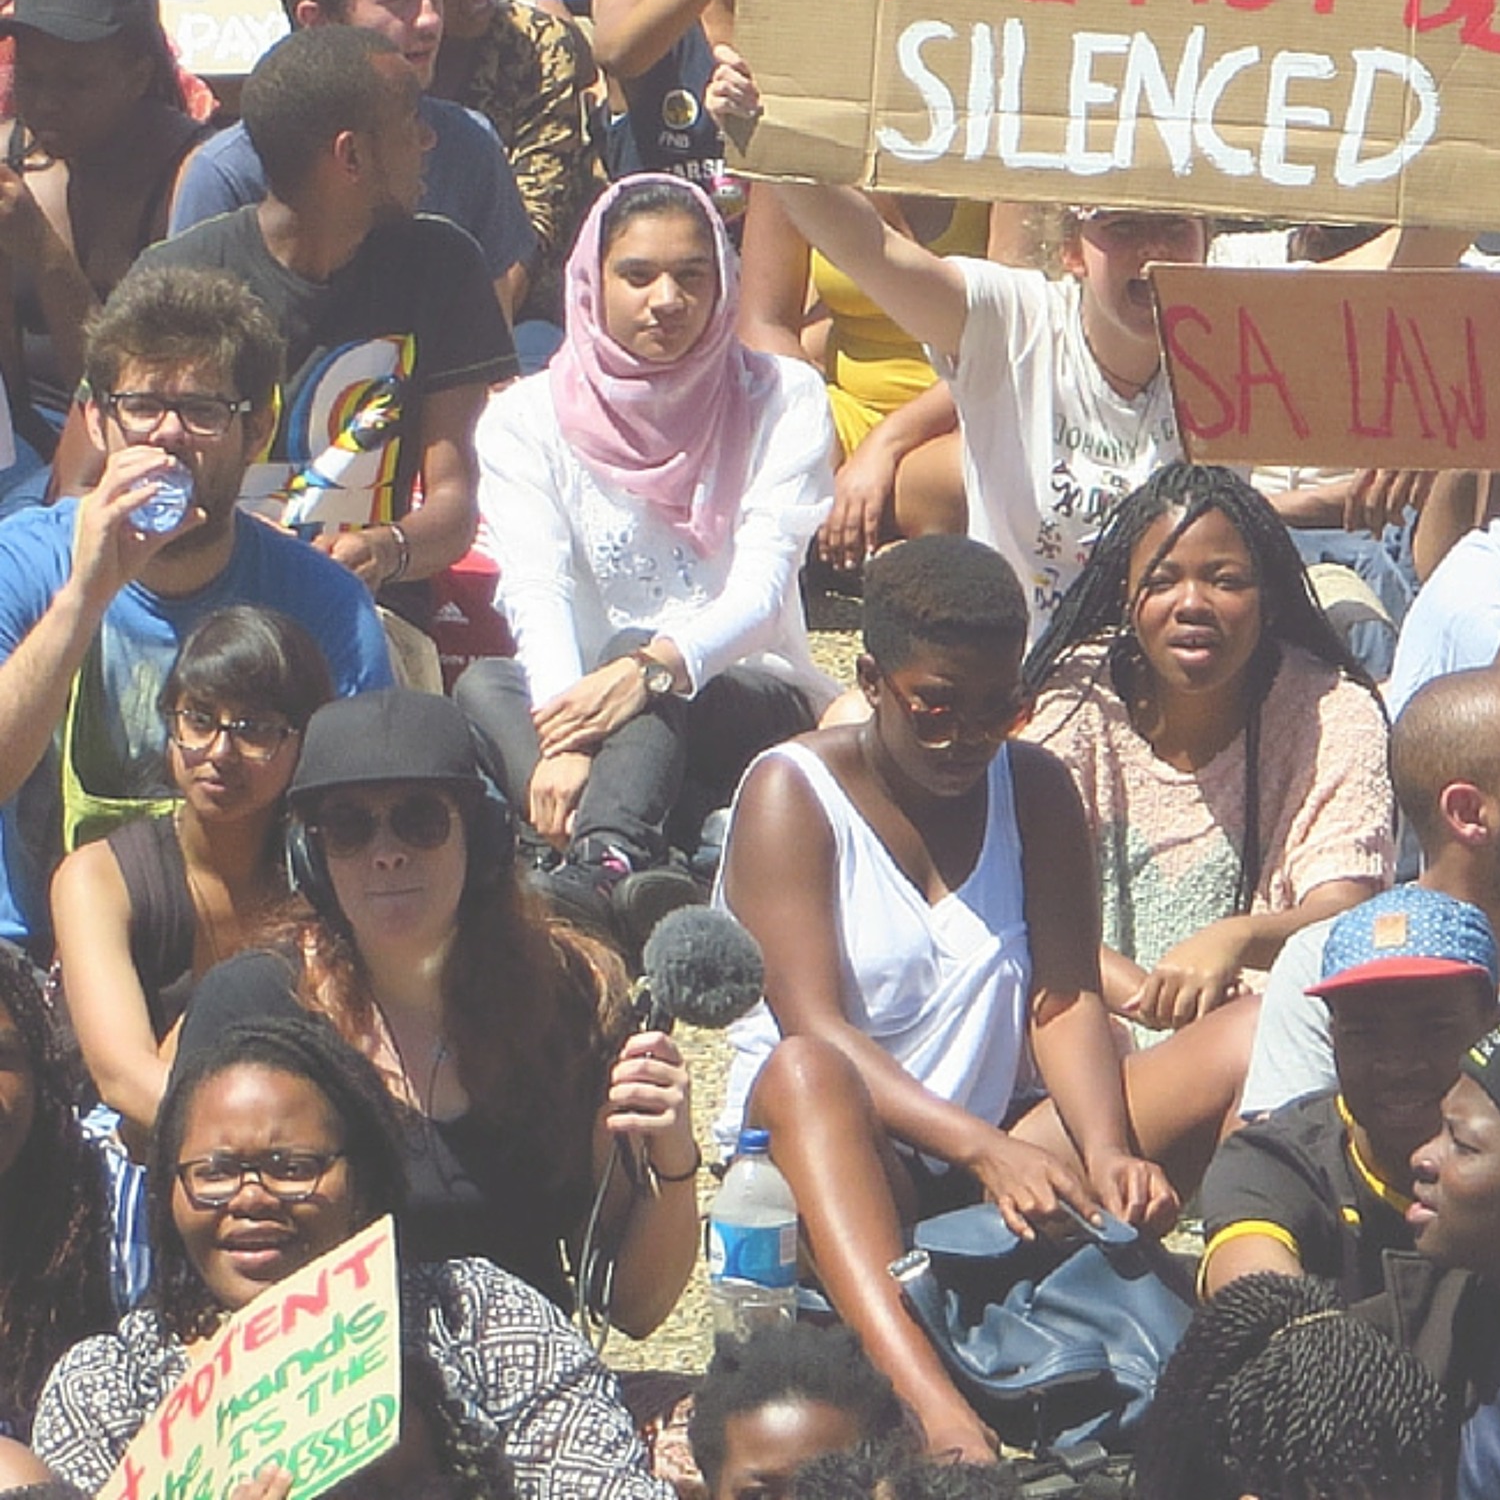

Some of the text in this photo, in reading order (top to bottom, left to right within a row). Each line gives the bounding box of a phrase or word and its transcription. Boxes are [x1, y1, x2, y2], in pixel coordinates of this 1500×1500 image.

[875, 17, 1442, 189] SILENCED
[1165, 303, 1310, 442] SA
[1342, 300, 1488, 449] LAW
[158, 1233, 387, 1459] POTENT
[227, 1334, 389, 1469] IS THE
